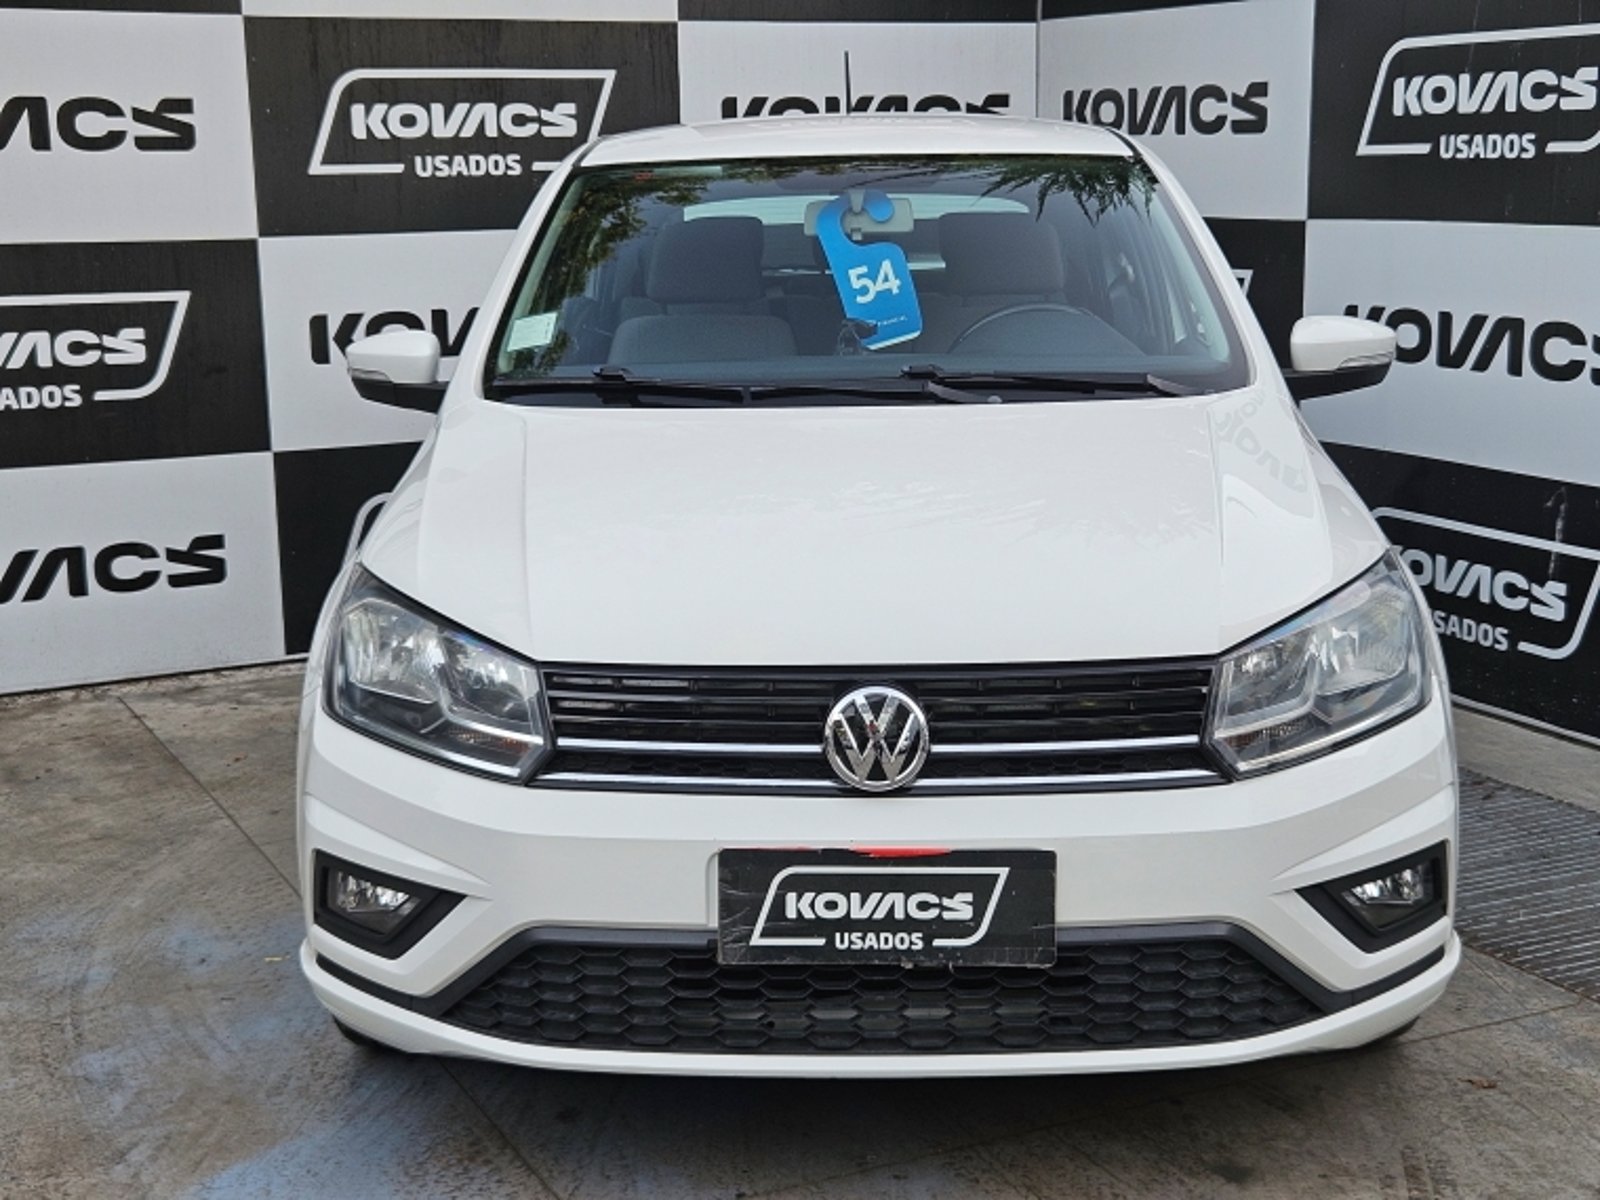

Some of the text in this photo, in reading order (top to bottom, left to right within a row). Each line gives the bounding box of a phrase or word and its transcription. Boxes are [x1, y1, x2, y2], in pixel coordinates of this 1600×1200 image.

[1063, 82, 1269, 135] KOVACS
[1393, 67, 1599, 116] KOVACS
[351, 102, 578, 140] KOVACS
[414, 154, 523, 178] USADOS
[1439, 132, 1536, 160] USADOS
[848, 259, 902, 304] 54
[1344, 304, 1600, 387] OVAC
[1391, 545, 1568, 623] OVACS
[825, 687, 930, 791] VW
[785, 892, 974, 921] KOVACS
[834, 931, 924, 950] USADOS
